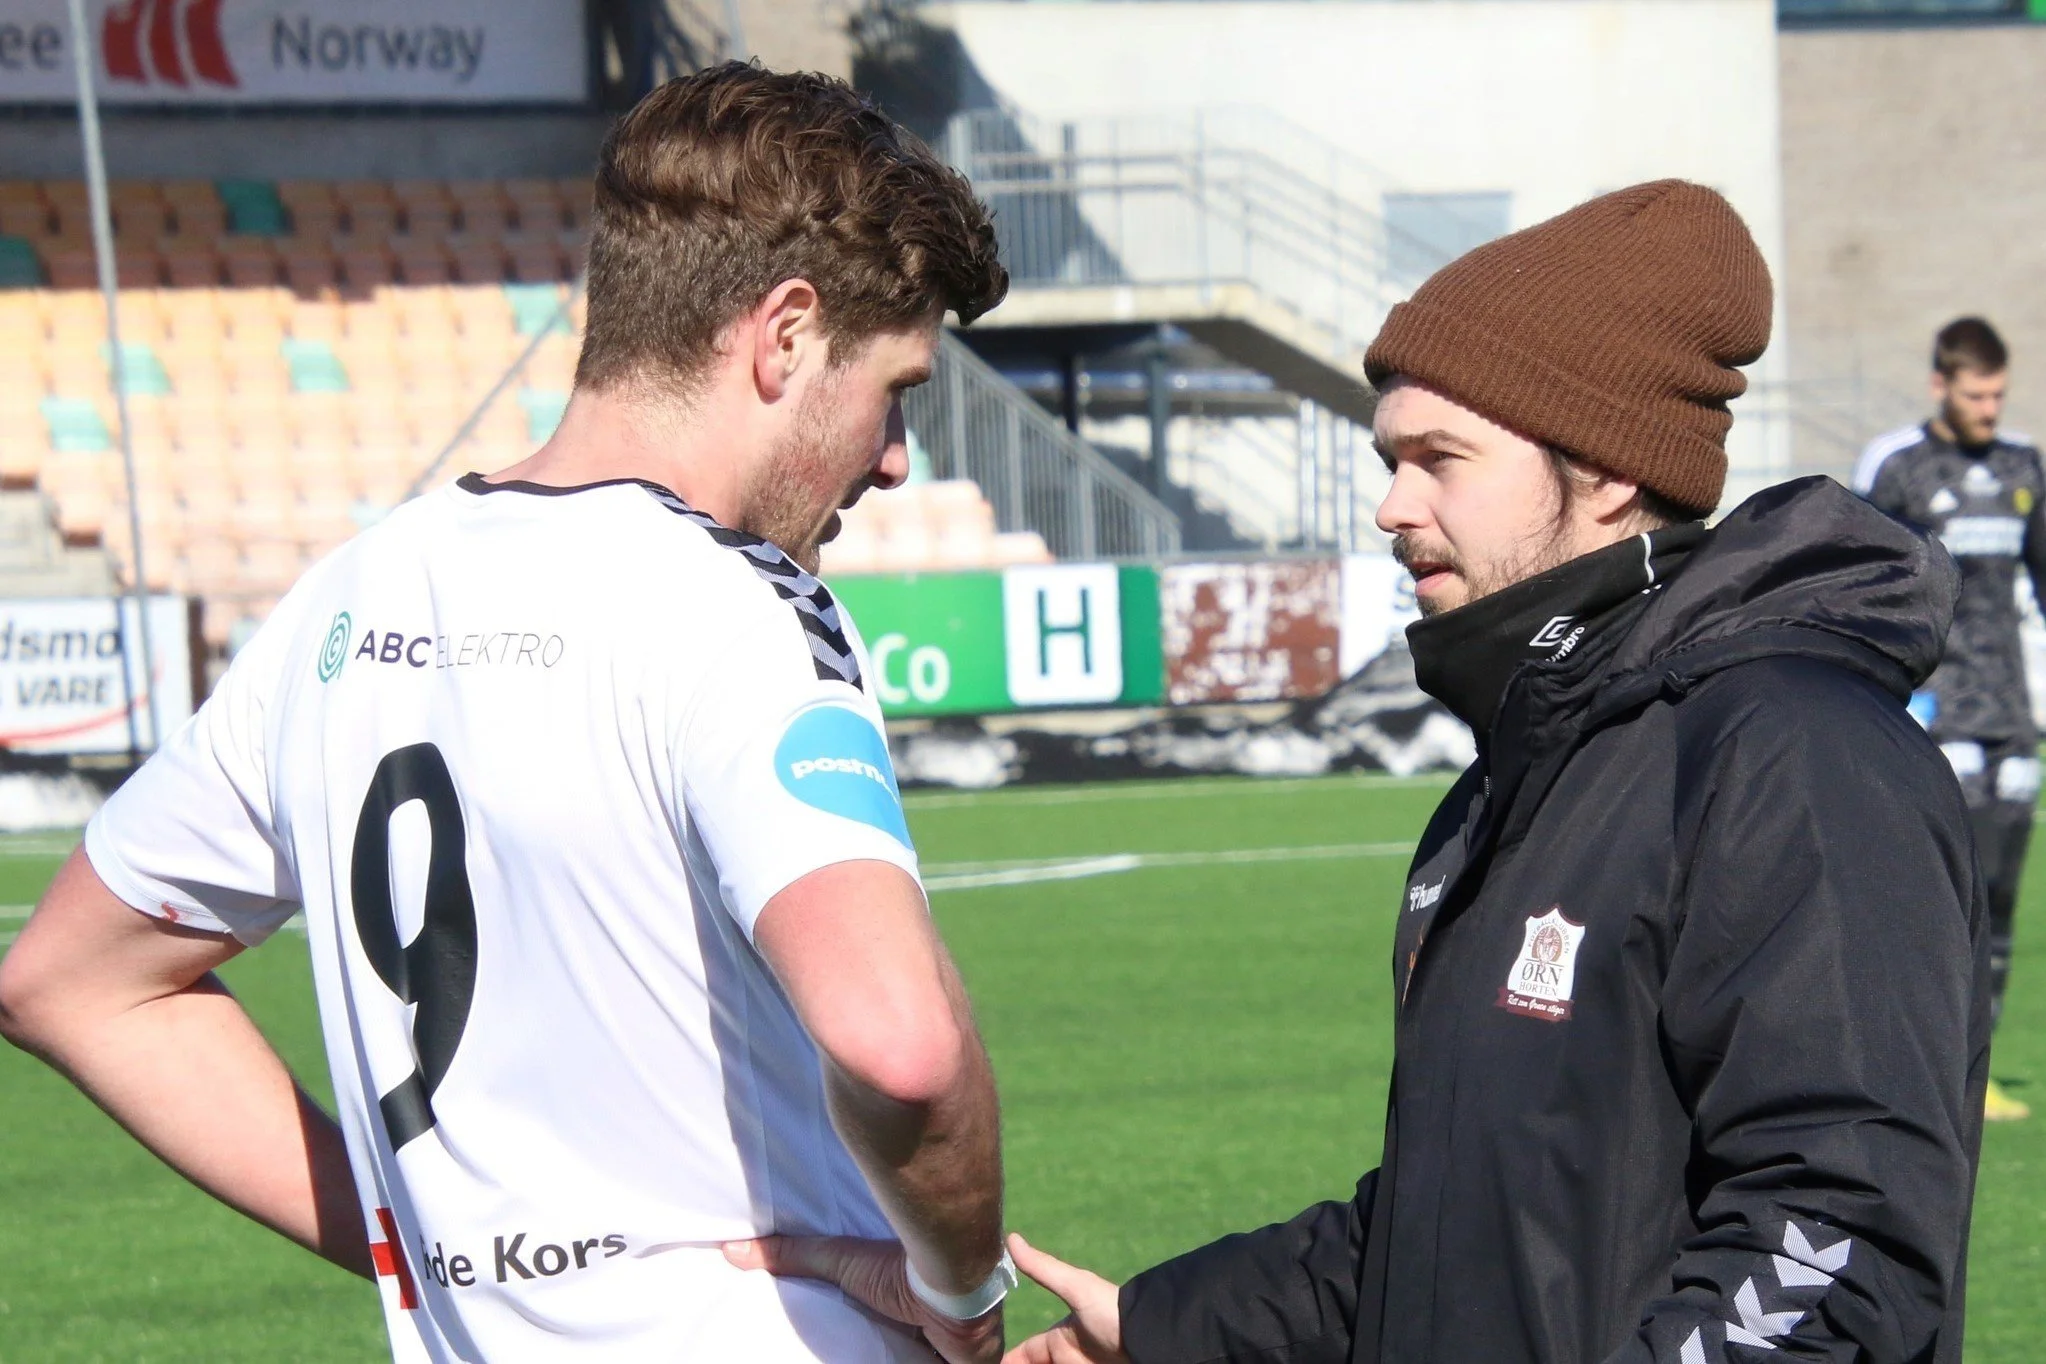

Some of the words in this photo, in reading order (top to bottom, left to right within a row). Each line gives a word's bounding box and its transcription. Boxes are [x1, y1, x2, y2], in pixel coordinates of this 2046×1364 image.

[271, 16, 485, 85] Norway
[1037, 587, 1091, 677] H
[17, 676, 112, 706] VARE
[872, 631, 950, 704] Co
[350, 742, 478, 1156] 9
[1521, 962, 1564, 987] ØRN
[1518, 981, 1559, 997] HORTEN
[493, 1232, 627, 1284] Kors
